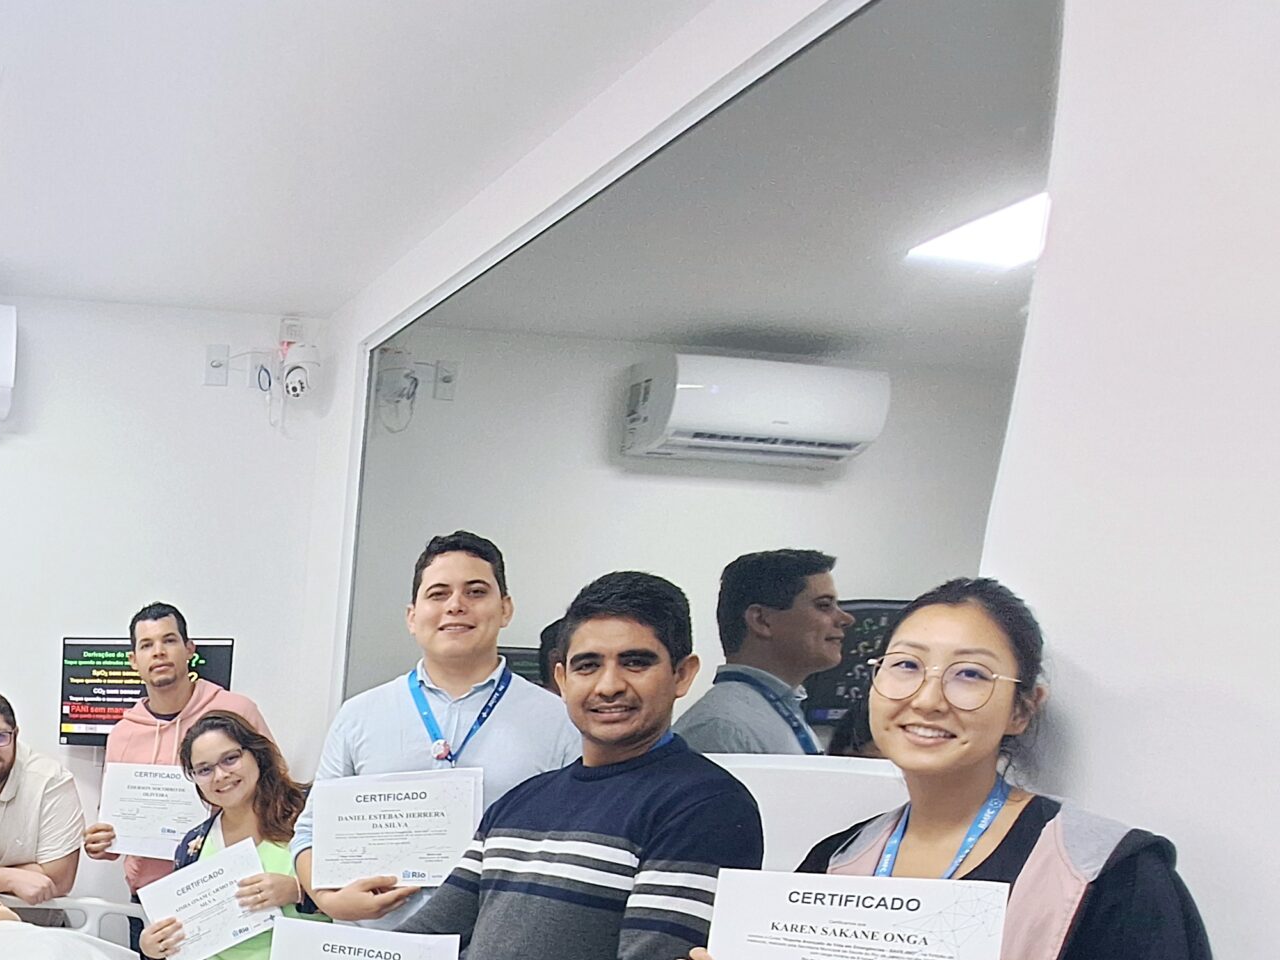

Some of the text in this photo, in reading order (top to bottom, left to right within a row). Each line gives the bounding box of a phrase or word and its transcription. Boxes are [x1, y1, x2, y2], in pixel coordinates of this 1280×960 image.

[135, 771, 181, 780] CERTIFICADO
[356, 791, 427, 803] CERTIFICADO
[176, 868, 224, 896] CERTIFICADO
[412, 871, 426, 879] Rio
[788, 891, 921, 912] CERTIFICADO
[771, 922, 929, 946] KAREN SAKANE ONGA
